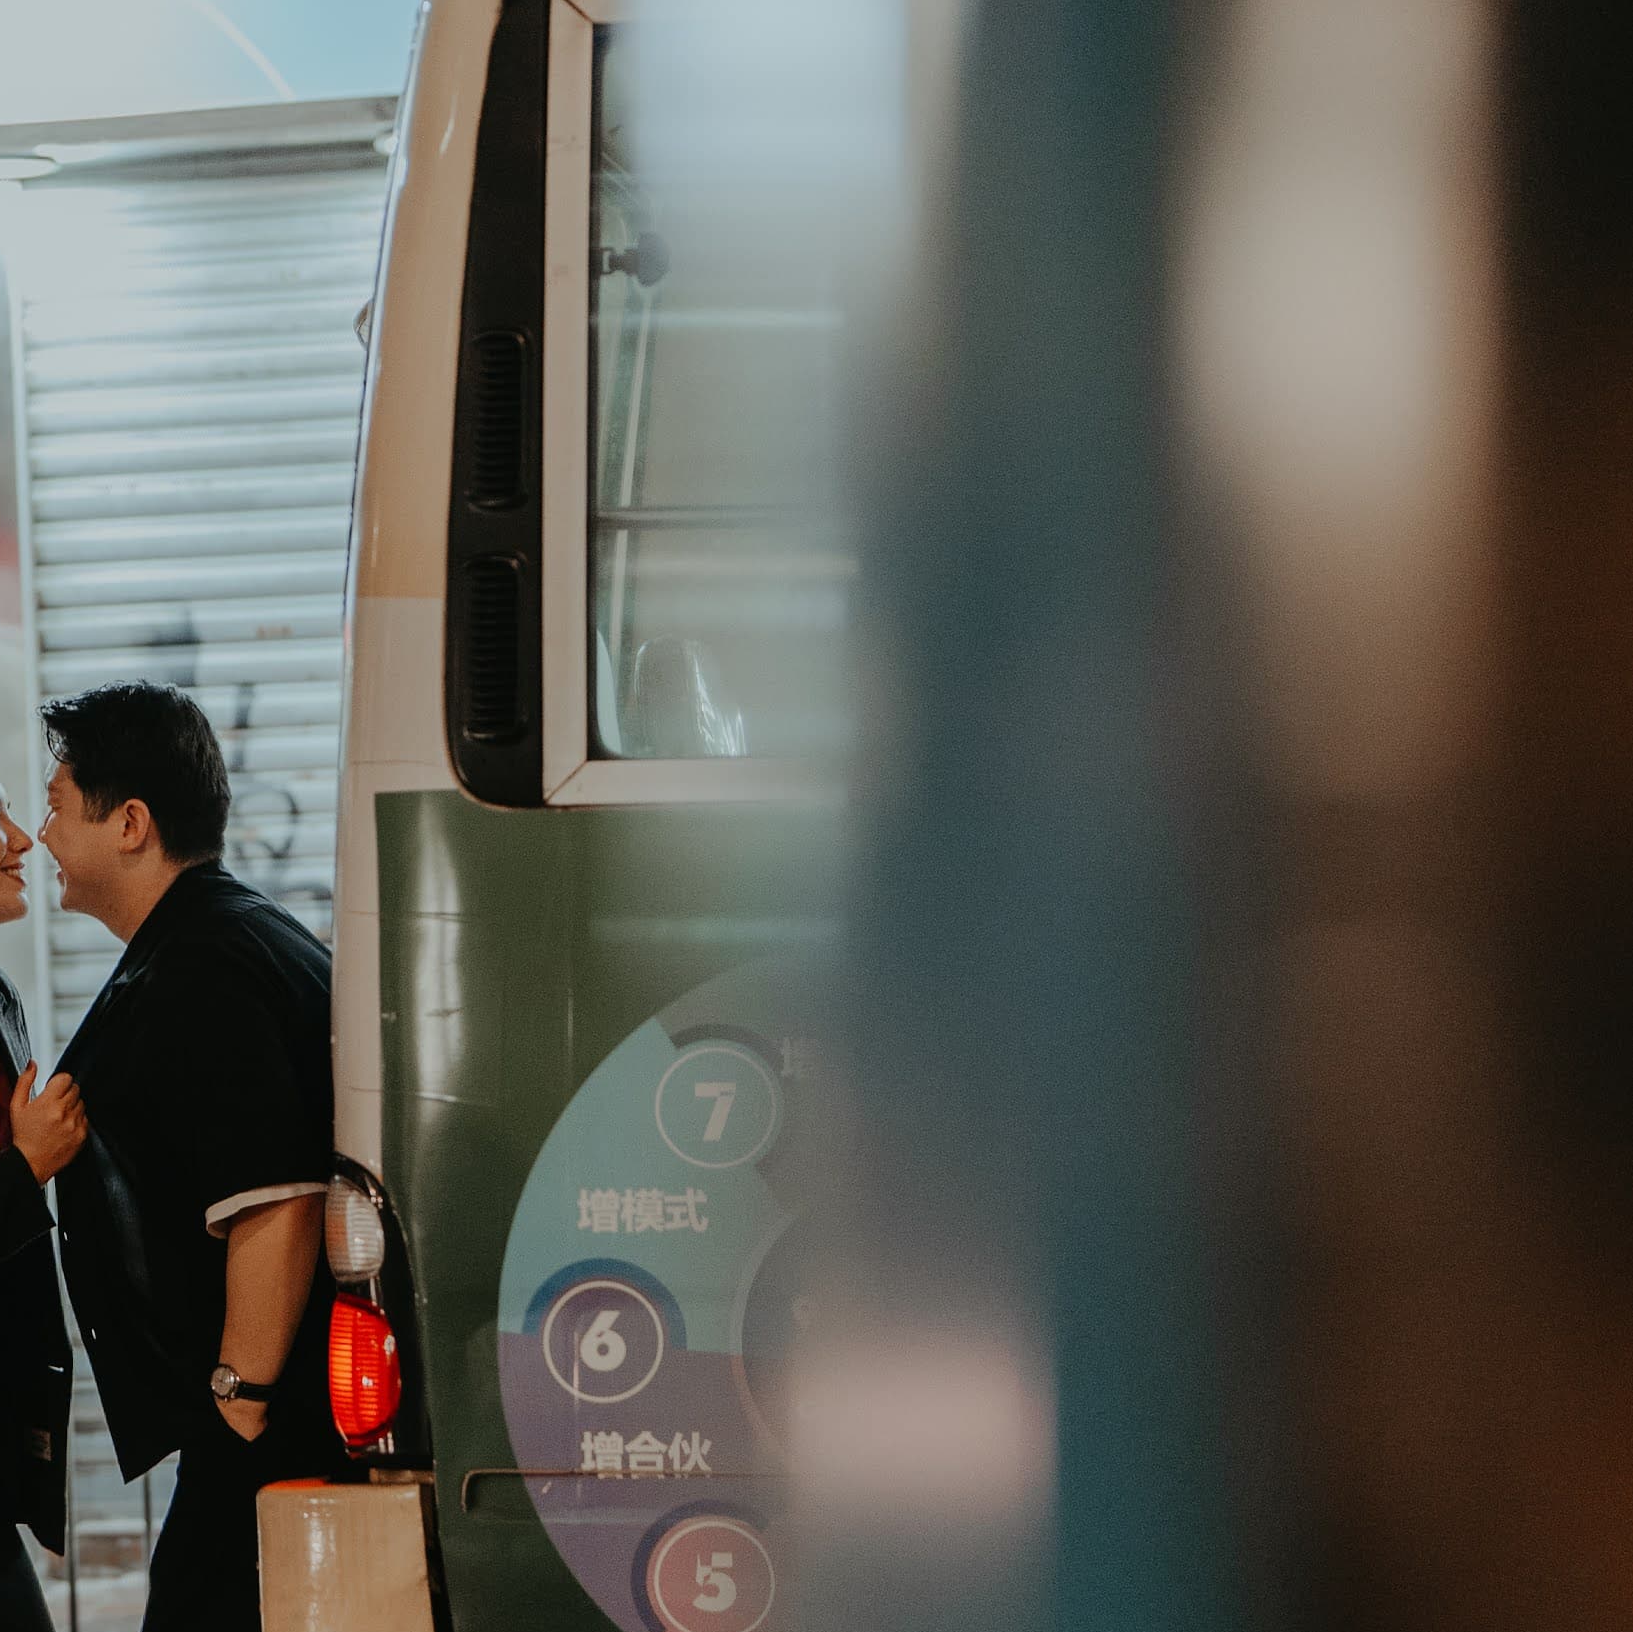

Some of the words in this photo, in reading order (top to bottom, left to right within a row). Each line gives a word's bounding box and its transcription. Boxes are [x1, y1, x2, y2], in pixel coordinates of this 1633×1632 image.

[693, 1081, 737, 1142] 7
[576, 1187, 710, 1234] 增模式
[578, 1309, 623, 1373] 6
[580, 1430, 713, 1480] 增合伙
[693, 1551, 738, 1614] 5
